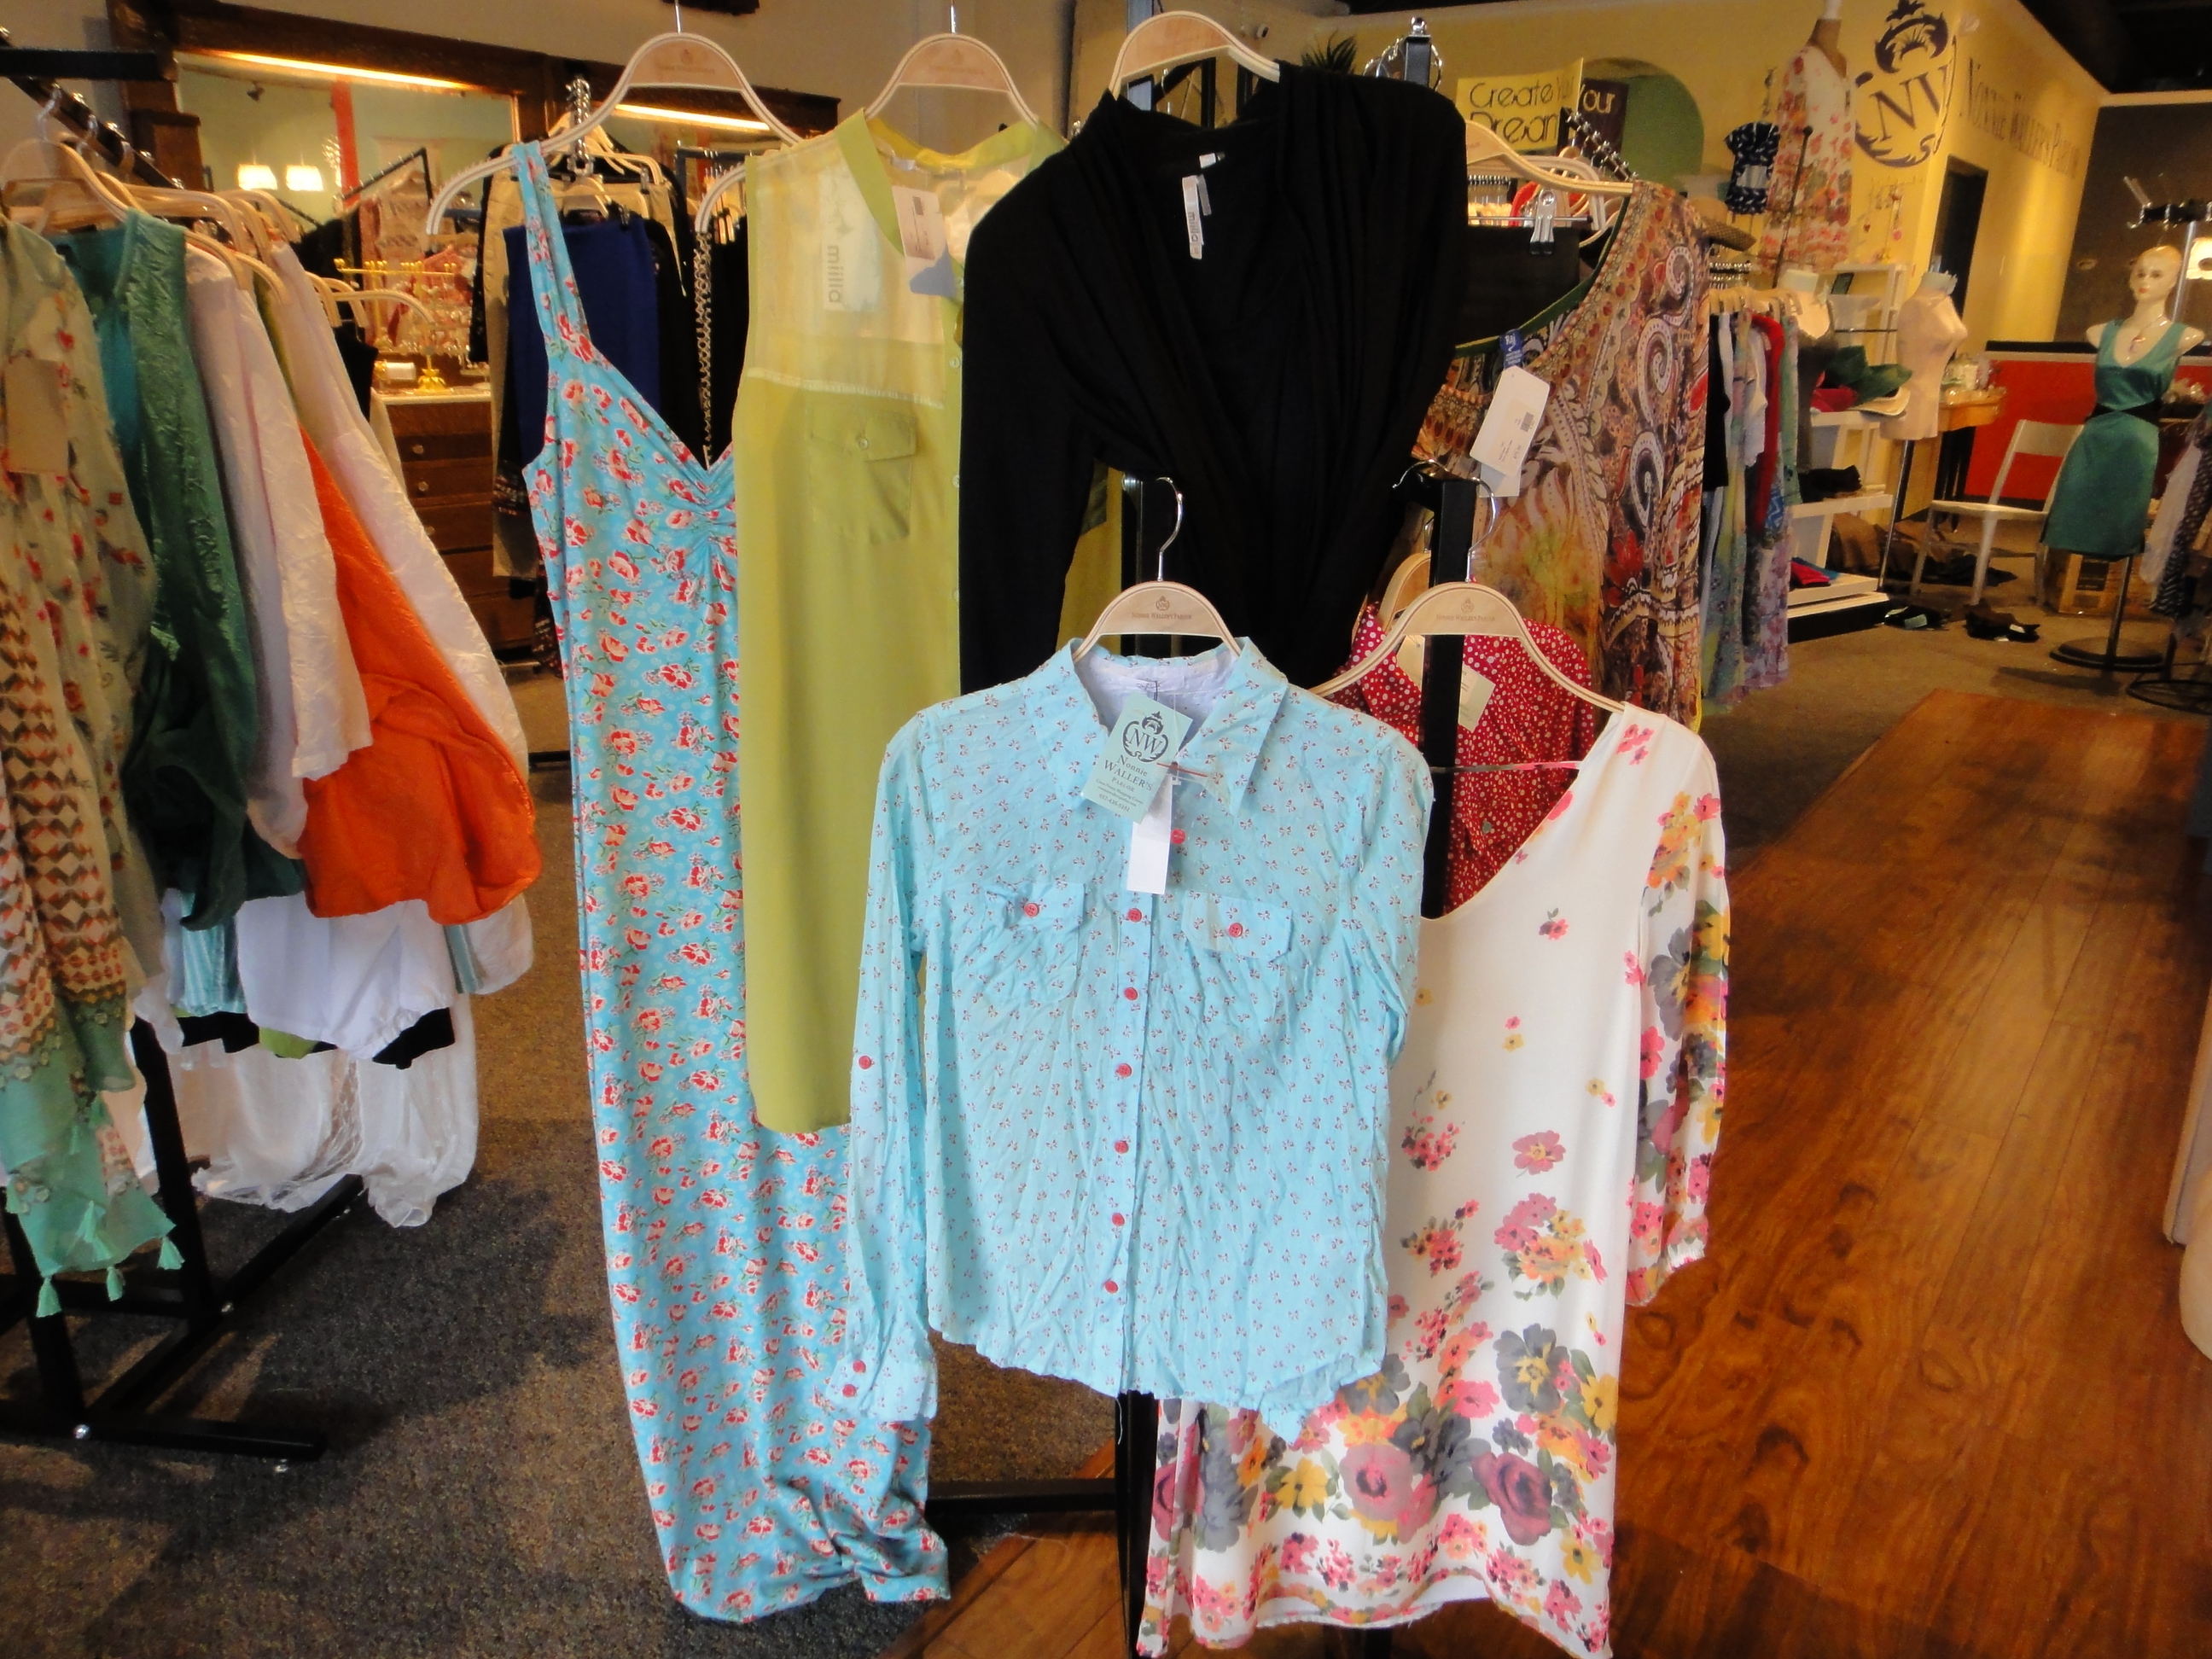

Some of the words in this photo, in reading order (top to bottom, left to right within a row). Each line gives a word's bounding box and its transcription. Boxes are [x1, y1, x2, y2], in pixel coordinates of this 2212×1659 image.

[1470, 80, 1553, 108] Create
[1129, 727, 1163, 754] NW
[1104, 760, 1153, 791] WALLER'S
[1116, 754, 1148, 777] Nonnie
[1111, 777, 1135, 792] PARLOR
